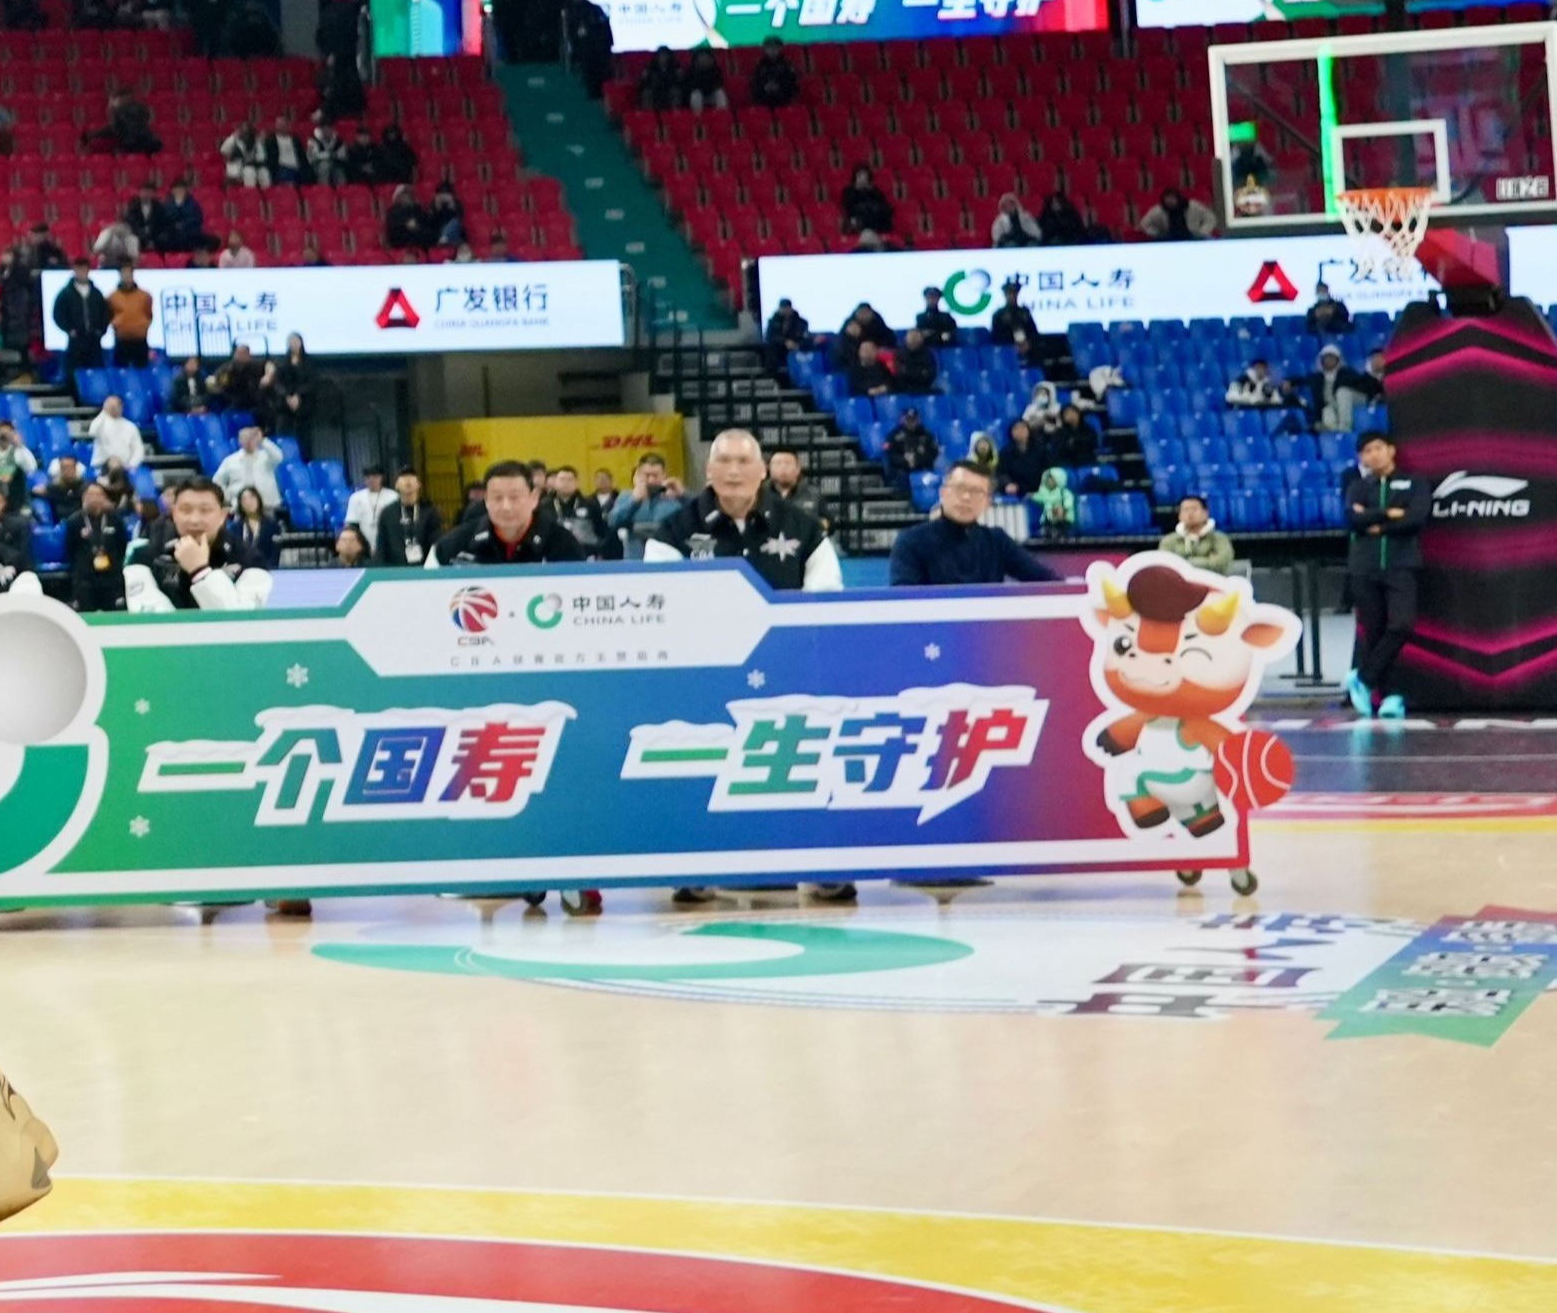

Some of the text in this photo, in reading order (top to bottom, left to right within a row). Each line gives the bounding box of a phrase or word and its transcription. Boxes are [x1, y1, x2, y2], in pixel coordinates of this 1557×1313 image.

[166, 290, 277, 316] 中国人寿
[435, 283, 548, 313] 广发银行
[1086, 296, 1134, 309] LIFE
[236, 319, 277, 332] LIFE
[602, 434, 656, 449] DHL
[1432, 499, 1531, 517] LI-NING
[572, 592, 666, 613] 中国人寿
[572, 613, 667, 627] CHINA LIFE
[457, 636, 495, 647] CBA
[144, 698, 1039, 818] 一个国寿 一生守护
